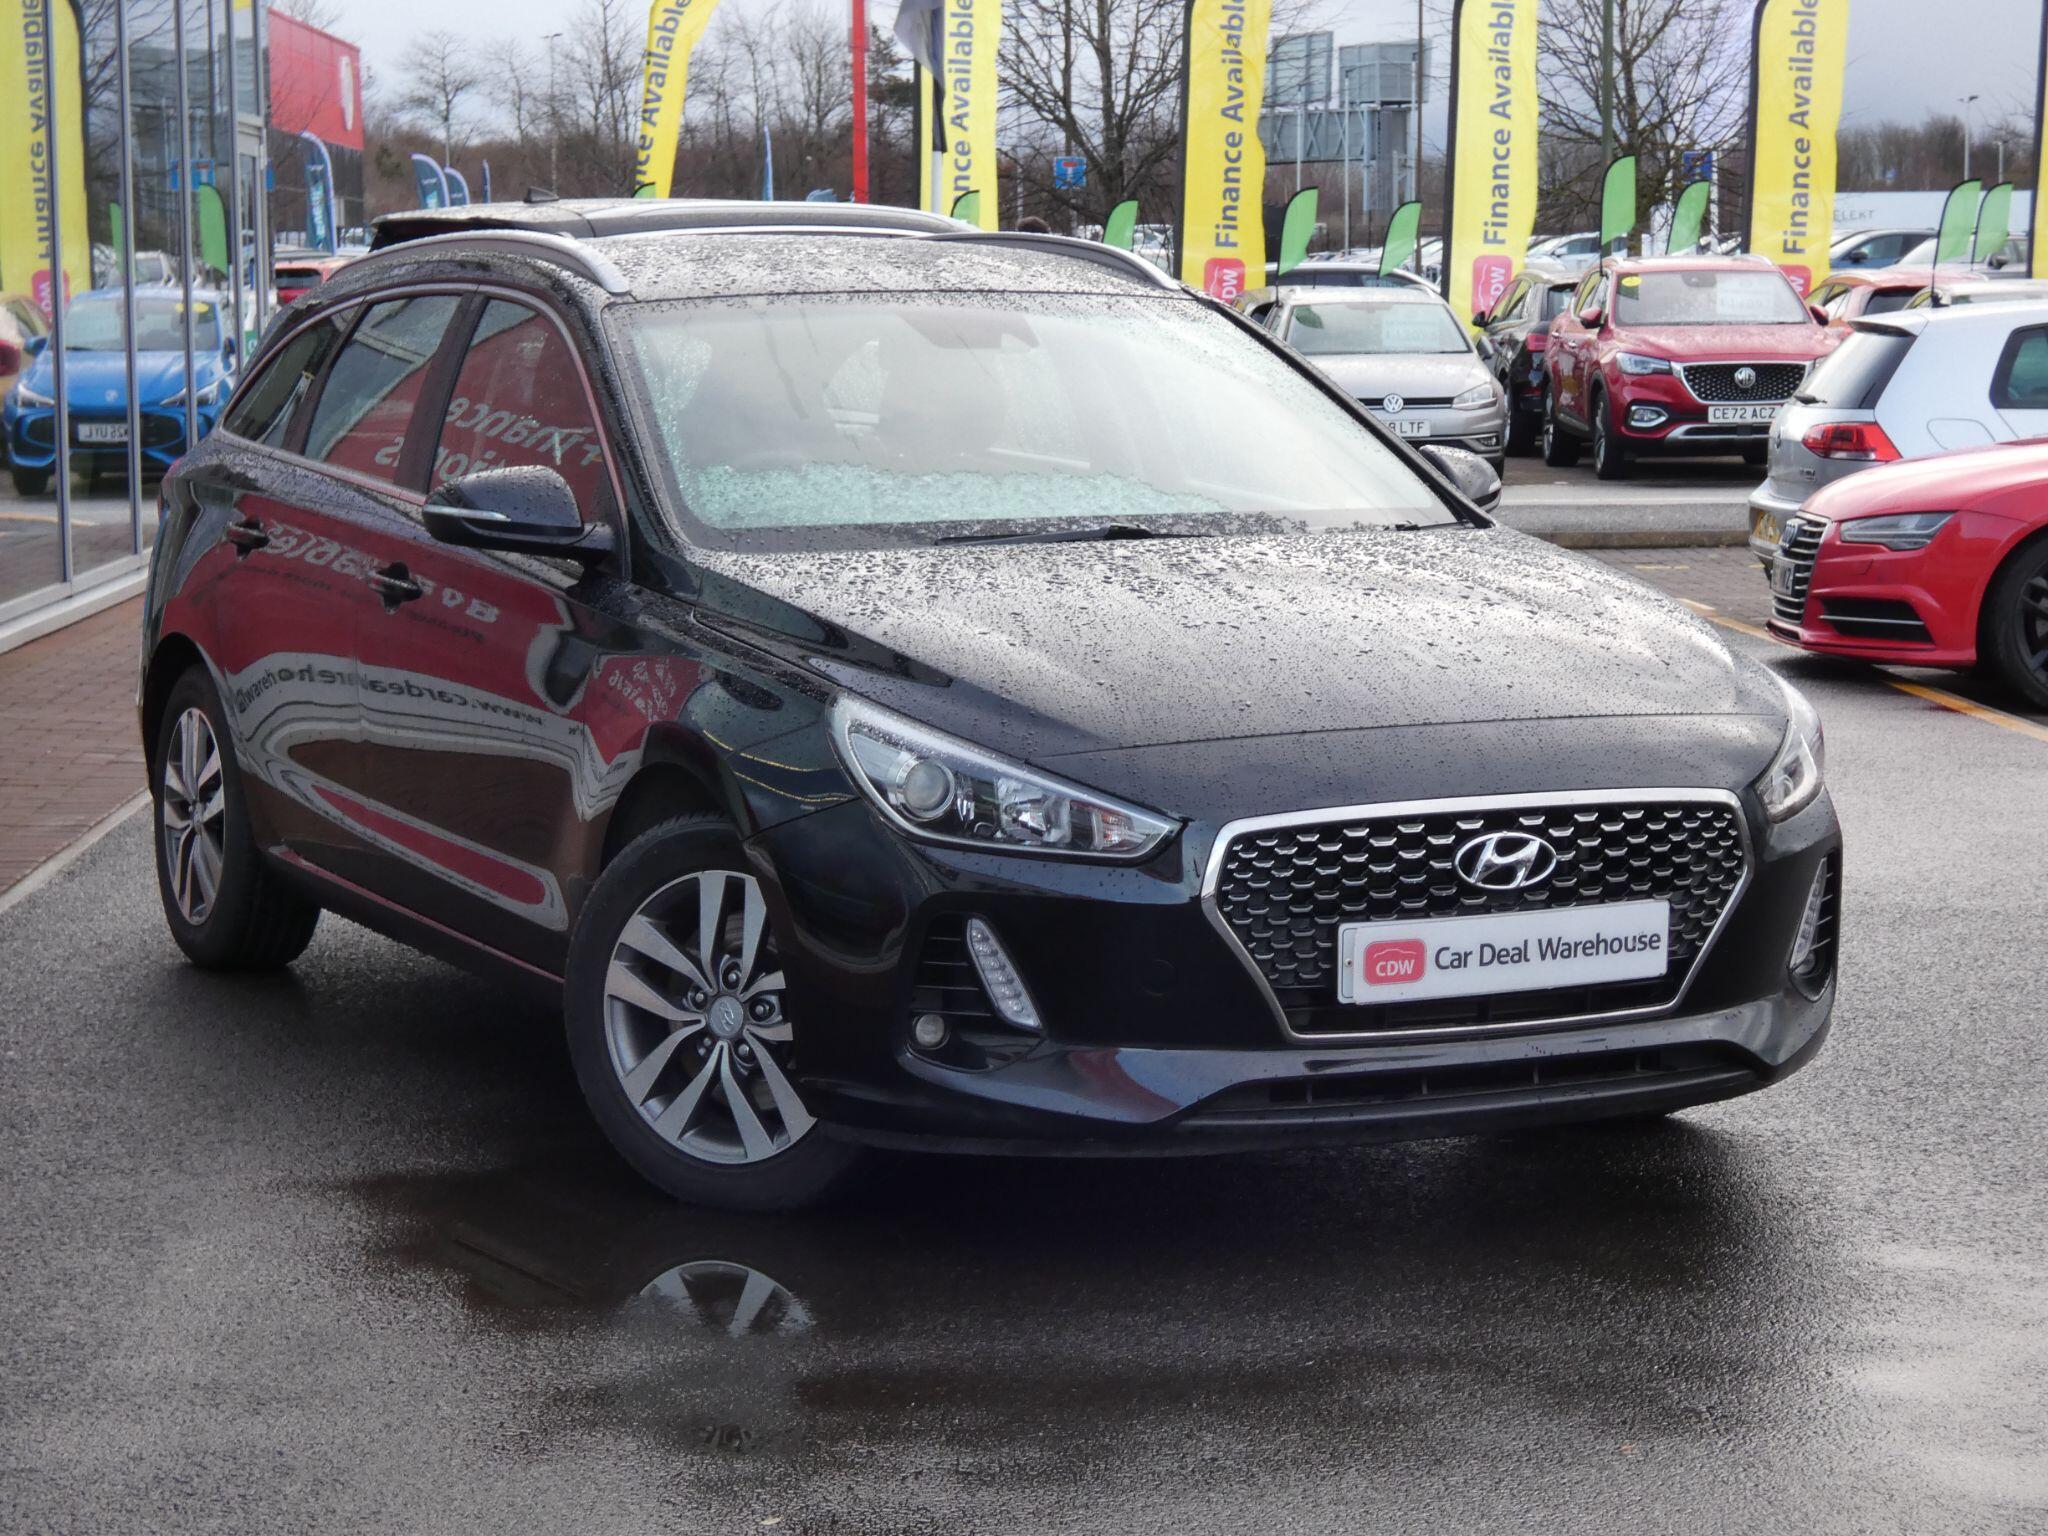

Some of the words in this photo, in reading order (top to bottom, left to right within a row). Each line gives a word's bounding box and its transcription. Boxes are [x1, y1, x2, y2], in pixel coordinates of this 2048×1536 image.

[947, 0, 974, 131] Available
[1220, 0, 1246, 123] Availabl
[1488, 0, 1515, 120] Availabl
[1788, 0, 1818, 130] Available
[1215, 131, 1243, 248] Finance
[1483, 128, 1511, 245] Finance
[1782, 138, 1811, 254] Finance
[1833, 209, 1875, 221] ELEKT
[1222, 268, 1238, 300] DW
[1400, 421, 1425, 434] LTF
[1713, 407, 1747, 420] CE72
[1751, 407, 1776, 420] ACZ
[1375, 959, 1415, 977] CDW
[1434, 946, 1473, 970] Car
[1479, 939, 1530, 967] Deal
[1538, 932, 1662, 962] Warehouse
